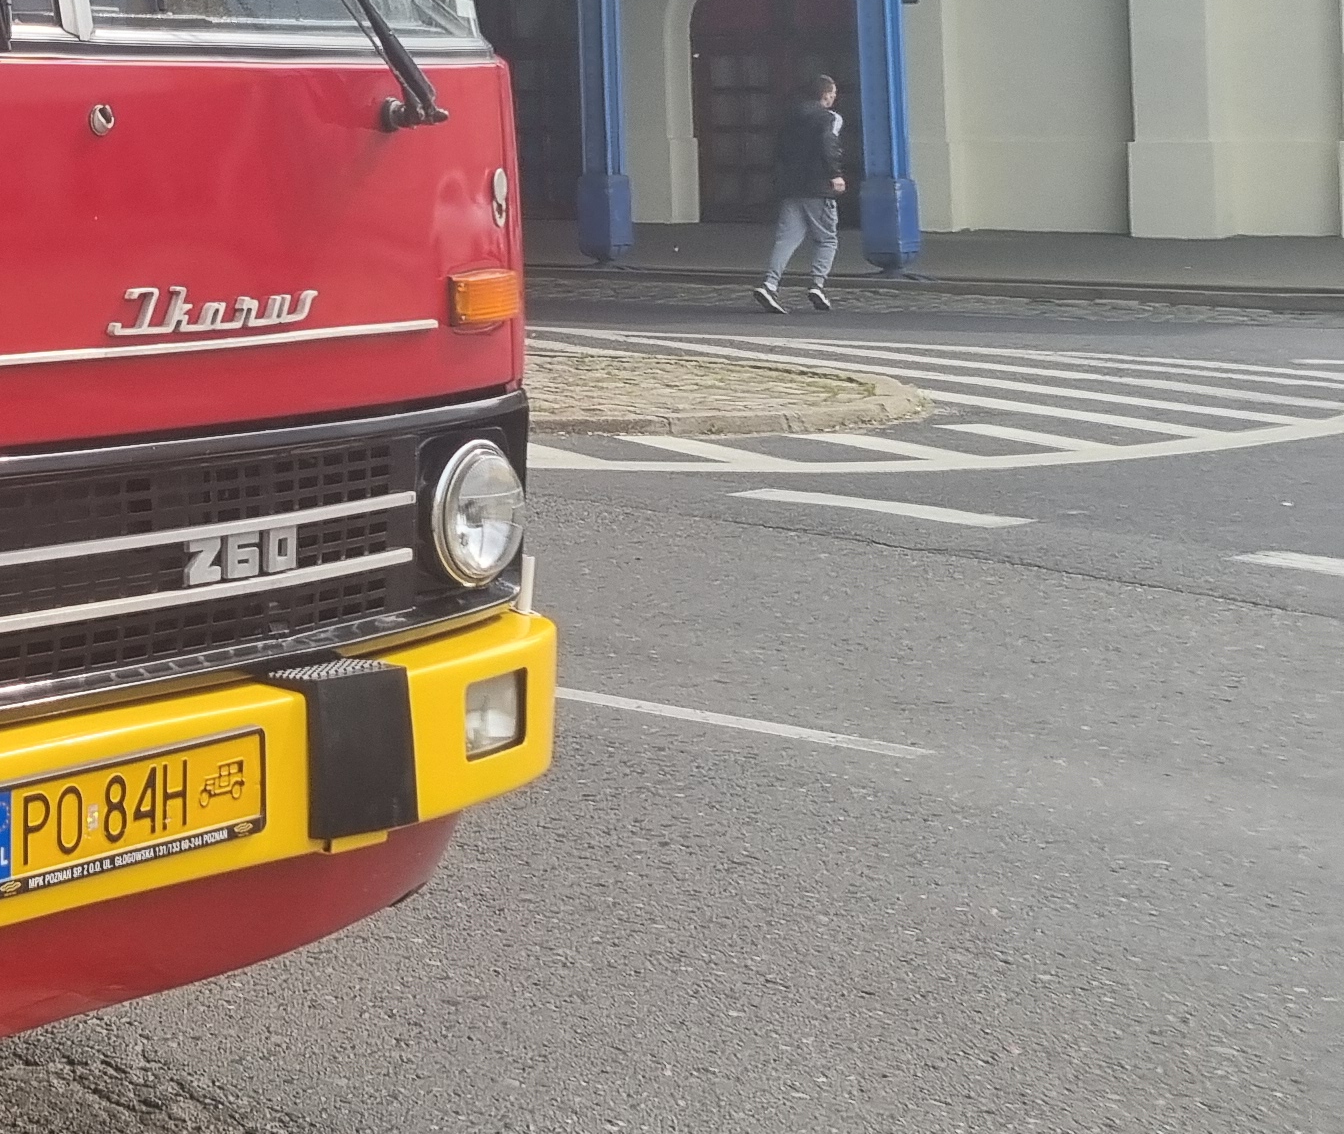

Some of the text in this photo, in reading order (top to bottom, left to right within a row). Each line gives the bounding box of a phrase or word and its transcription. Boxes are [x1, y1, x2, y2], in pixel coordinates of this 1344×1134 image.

[106, 285, 319, 337] Ikarus
[183, 525, 297, 587] 260
[22, 757, 189, 866] PO 84H
[28, 875, 44, 889] MPK
